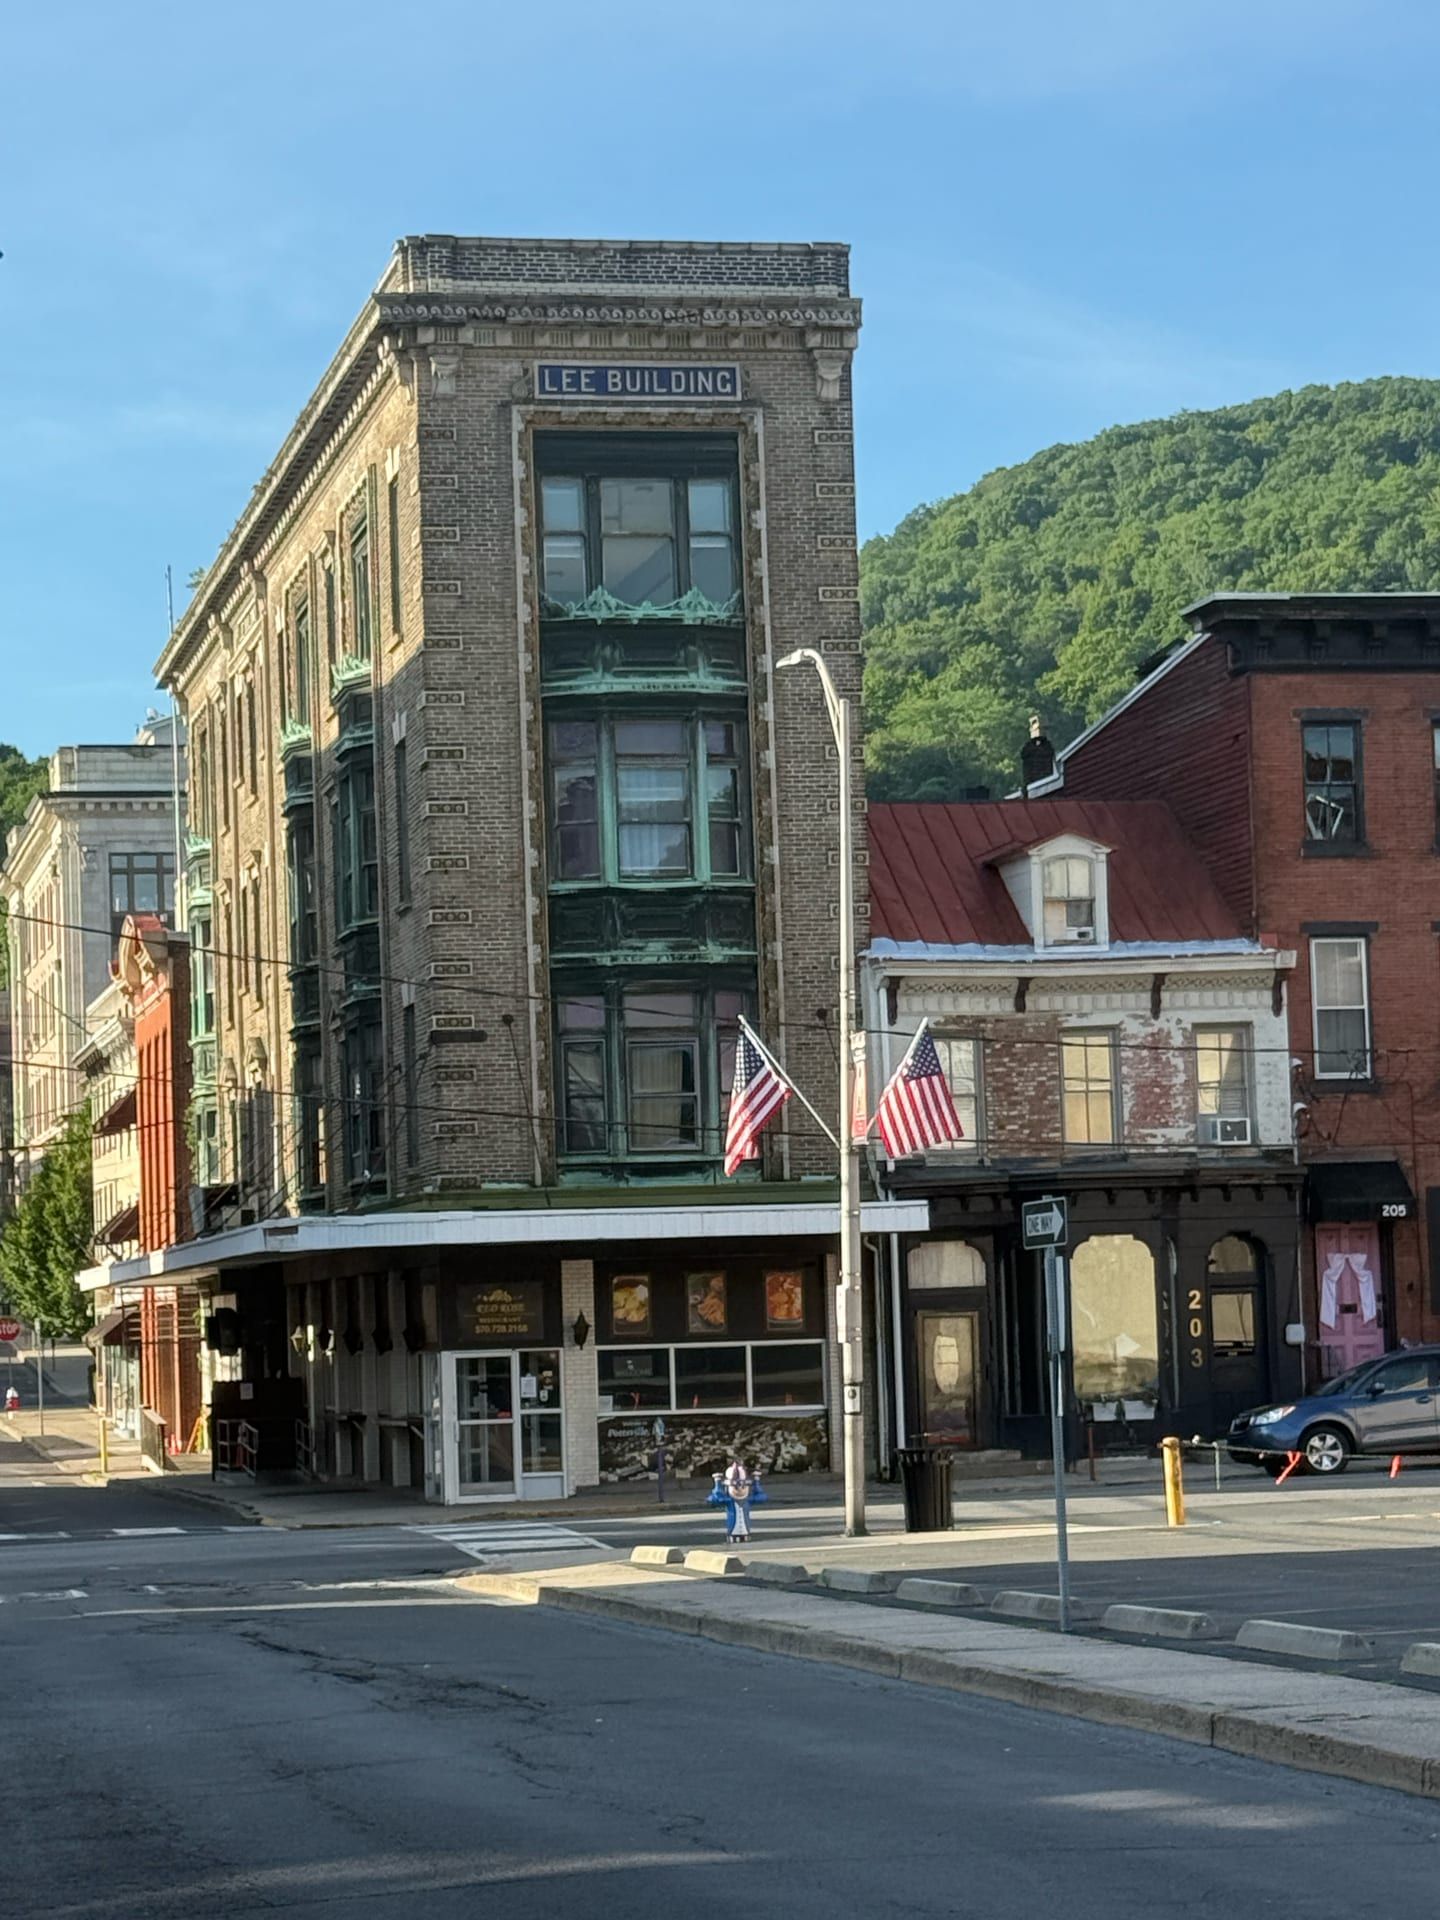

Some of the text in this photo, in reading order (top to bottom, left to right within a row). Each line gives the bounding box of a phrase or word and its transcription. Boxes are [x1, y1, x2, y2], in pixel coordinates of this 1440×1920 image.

[544, 368, 732, 394] LEE BUILDING
[1382, 1204, 1407, 1217] 205
[1028, 1213, 1053, 1235] ONE WAY
[1188, 1289, 1203, 1368] 203
